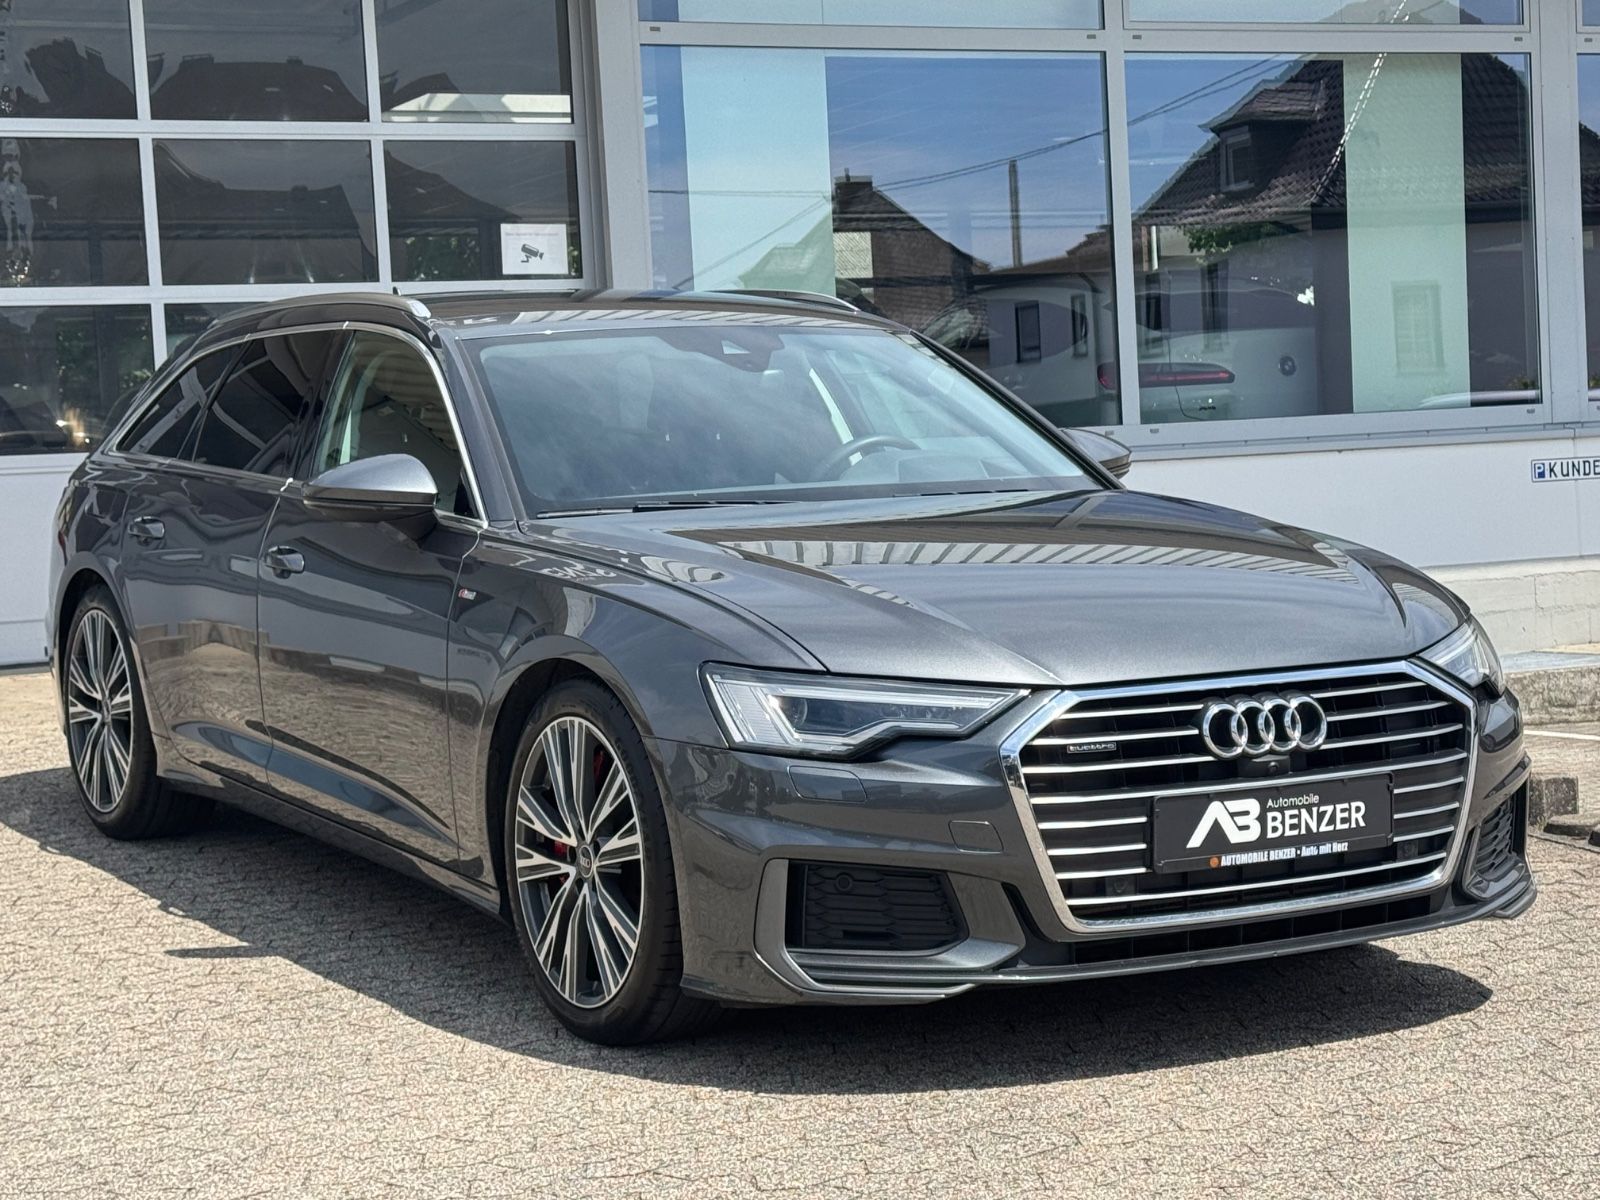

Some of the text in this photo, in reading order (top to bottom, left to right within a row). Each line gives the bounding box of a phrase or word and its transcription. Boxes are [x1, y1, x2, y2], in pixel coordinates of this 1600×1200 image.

[1549, 460, 1600, 478] KUNDE
[1266, 793, 1320, 809] Automobile
[1266, 801, 1366, 839] BENZER
[1220, 850, 1269, 867] AUTOMOBILE
[1269, 847, 1297, 861] BENZER
